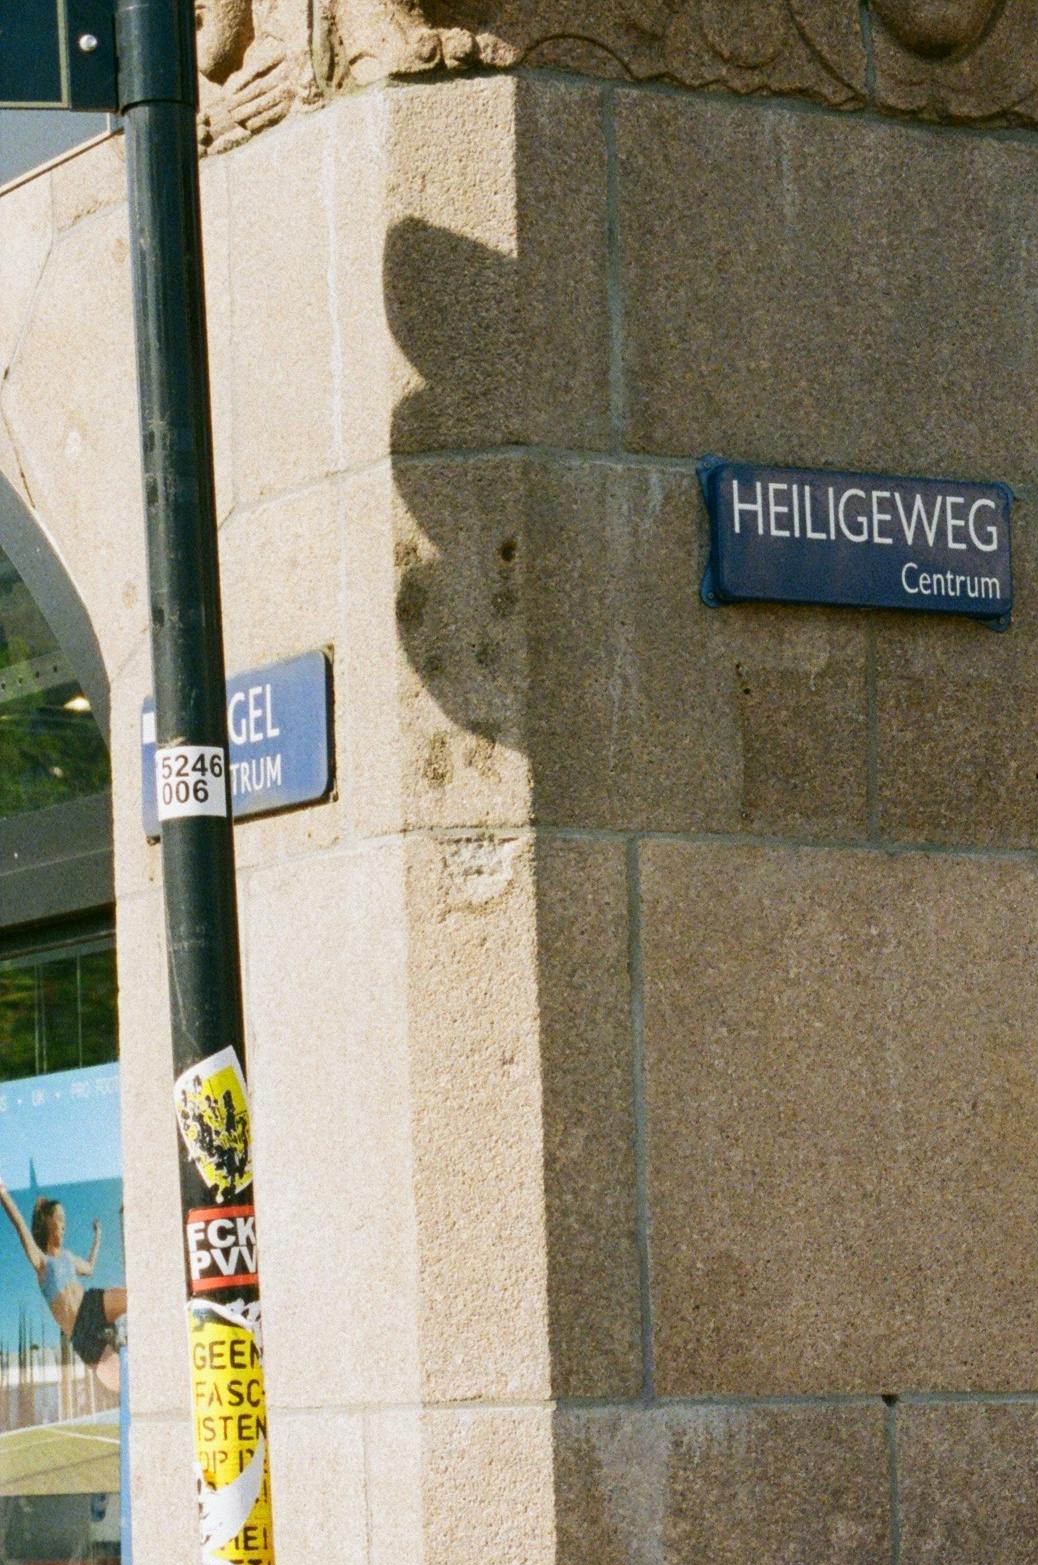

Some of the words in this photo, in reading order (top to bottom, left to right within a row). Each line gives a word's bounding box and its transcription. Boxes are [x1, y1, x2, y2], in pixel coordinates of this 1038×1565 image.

[732, 479, 998, 552] HEILIGEWEG
[901, 562, 1001, 600] Centrum
[228, 684, 280, 745] GEL
[162, 754, 223, 780] 5246
[229, 754, 282, 796] TRUM
[162, 780, 209, 806] 006
[187, 1216, 257, 1252] FCK
